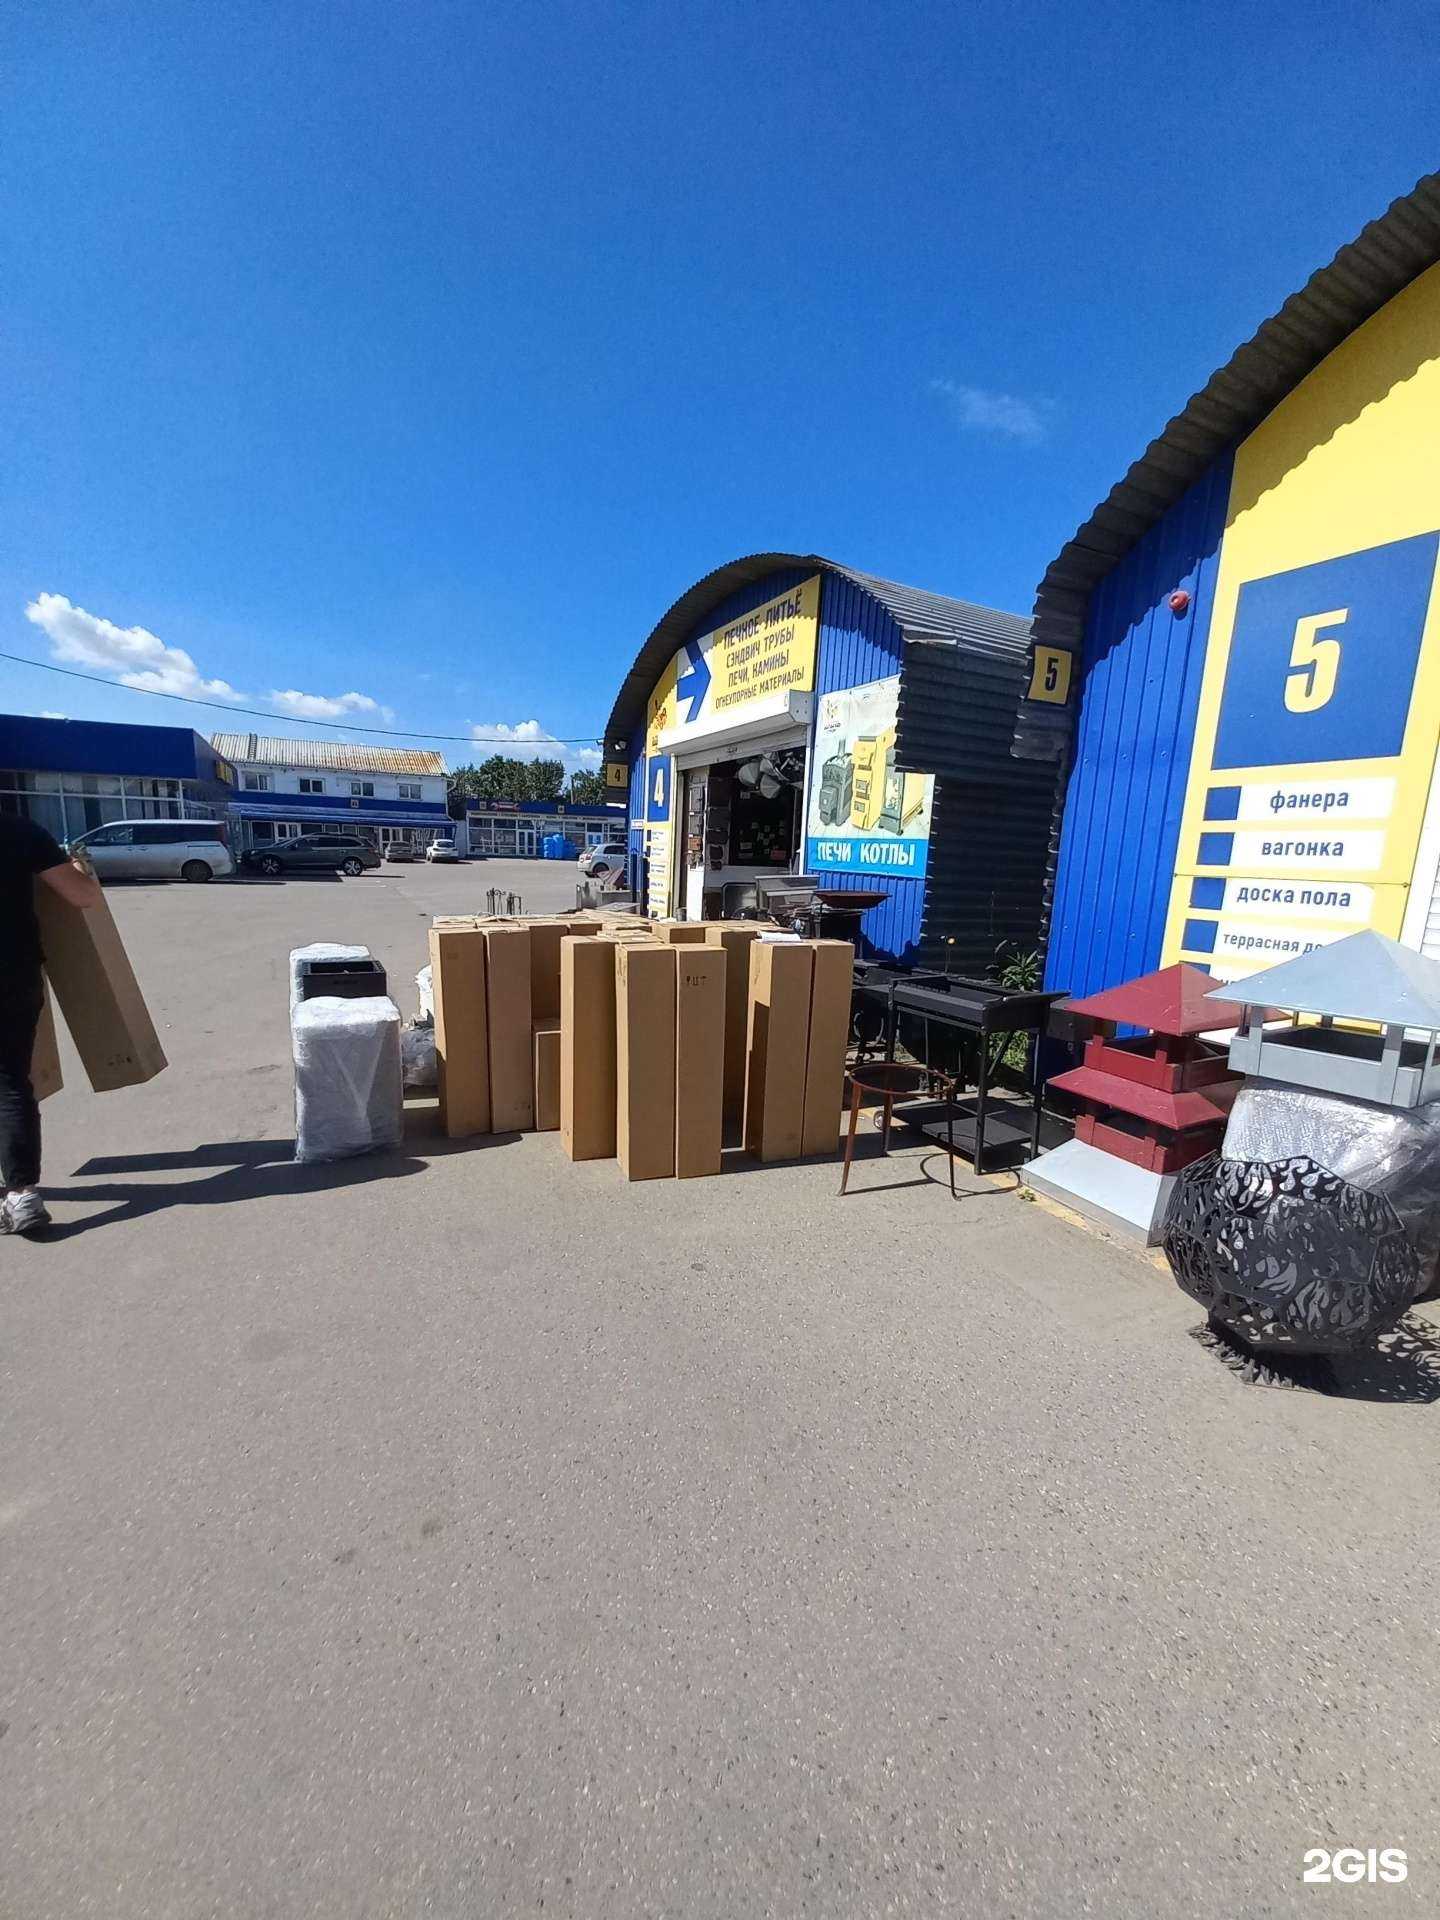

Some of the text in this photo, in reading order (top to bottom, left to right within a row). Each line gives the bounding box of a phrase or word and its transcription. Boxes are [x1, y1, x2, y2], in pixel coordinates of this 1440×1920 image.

[723, 588, 803, 650] ПЕЧНОЕ ЛИТЬЁ
[726, 623, 795, 669] СЭНДВИЧ ТРУБЫ
[1284, 607, 1349, 713] 5
[752, 649, 790, 679] КАМИНЫ
[1044, 656, 1060, 692] 5
[759, 666, 805, 693] МАТЕРИАЛЫ
[653, 767, 665, 808] 4
[1269, 790, 1349, 814] фанера
[816, 840, 915, 866] ПЕЧИ КОТЛЫ
[1261, 841, 1344, 857] вагонка
[1236, 887, 1351, 907] доска пола
[1222, 933, 1300, 953] террасная
